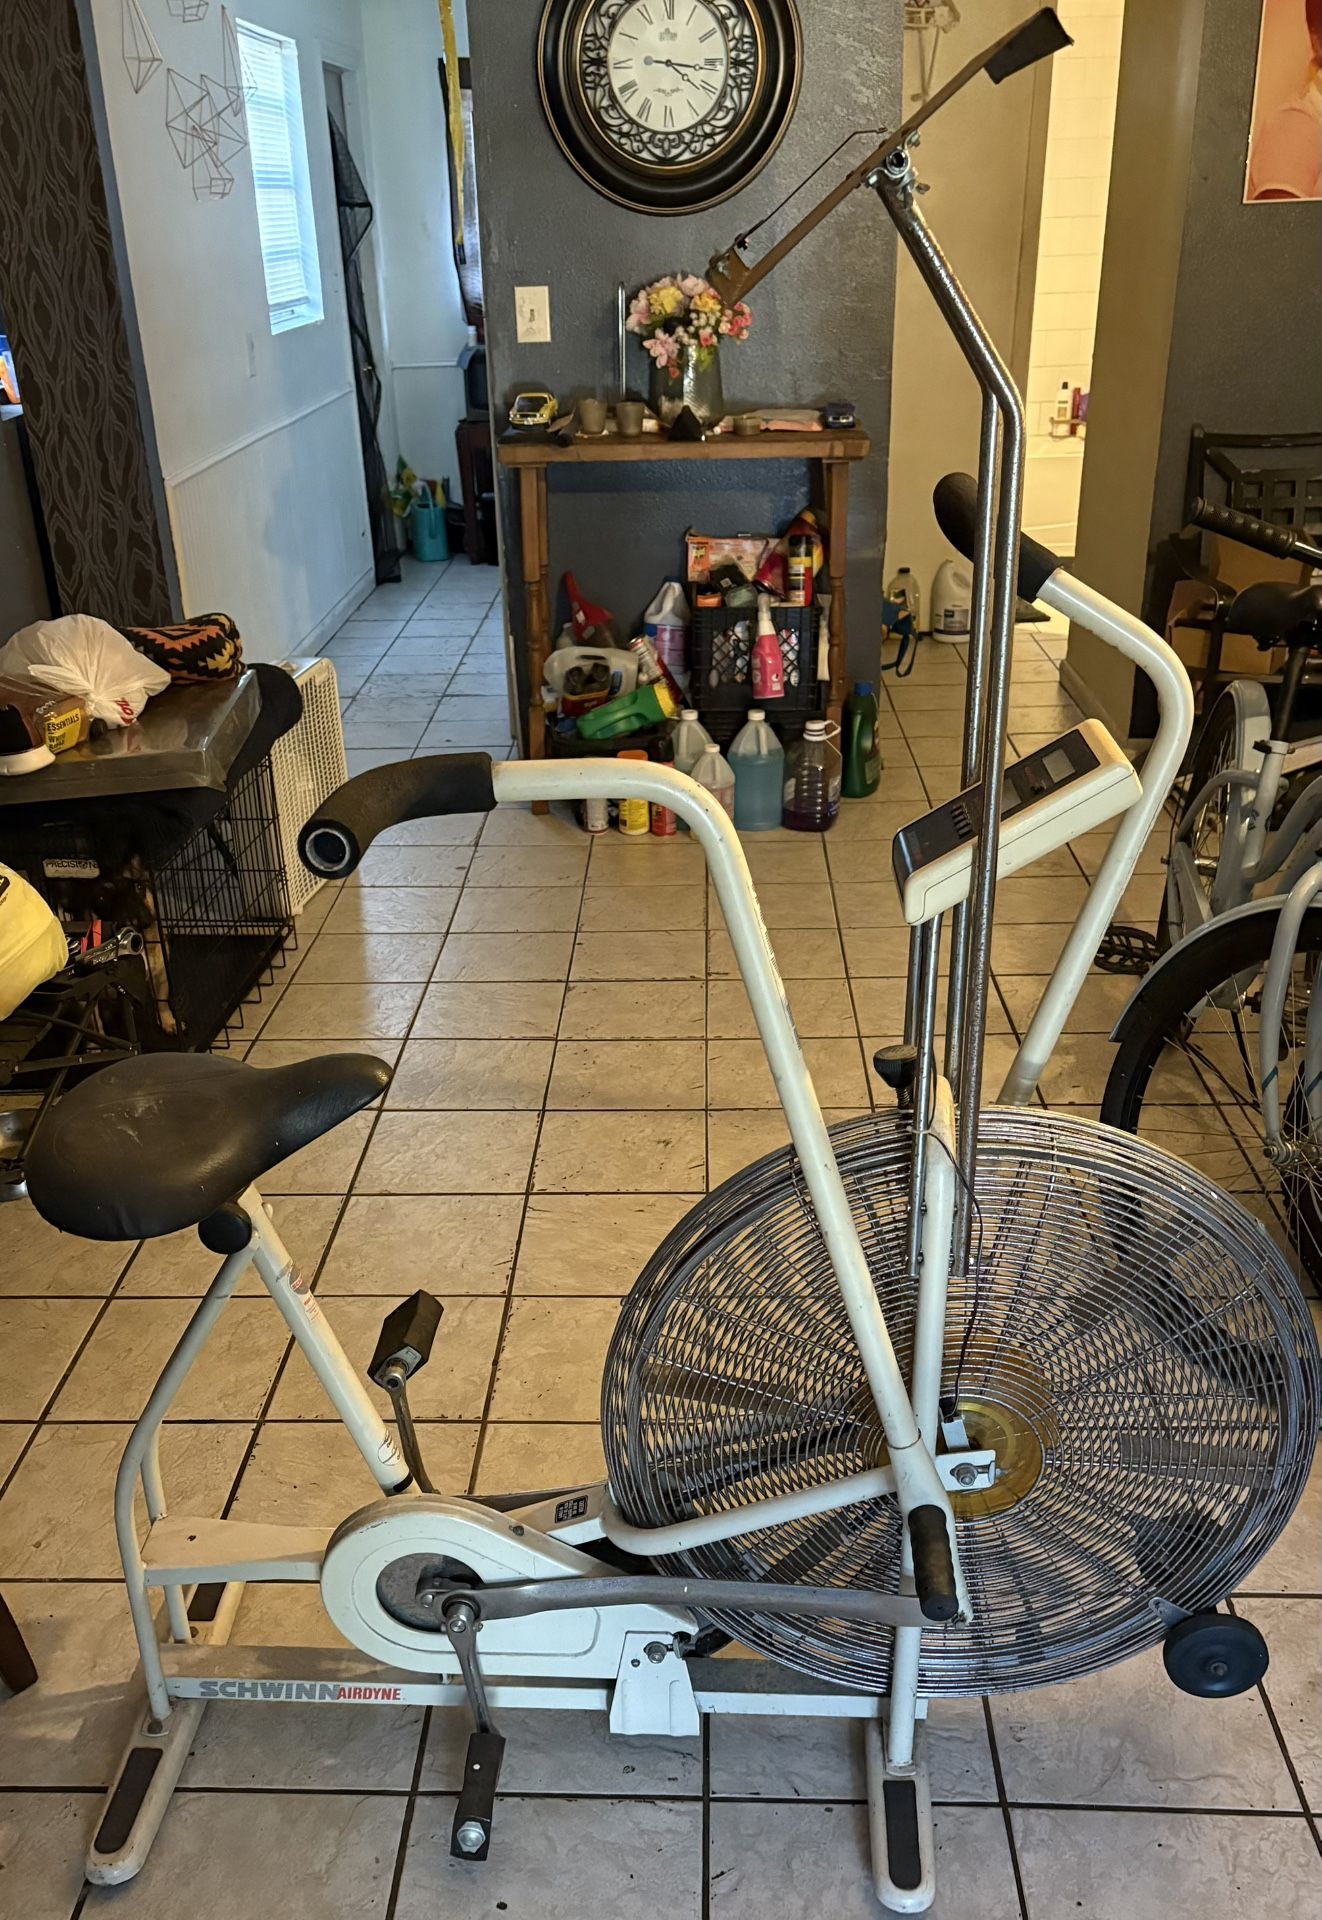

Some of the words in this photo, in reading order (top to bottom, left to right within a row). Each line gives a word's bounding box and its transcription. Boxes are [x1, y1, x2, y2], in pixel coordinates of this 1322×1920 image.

[47, 713, 80, 731] ESSENTIALS
[199, 1681, 341, 1701] SCHWINN
[337, 1686, 402, 1701] AIRDYNE
